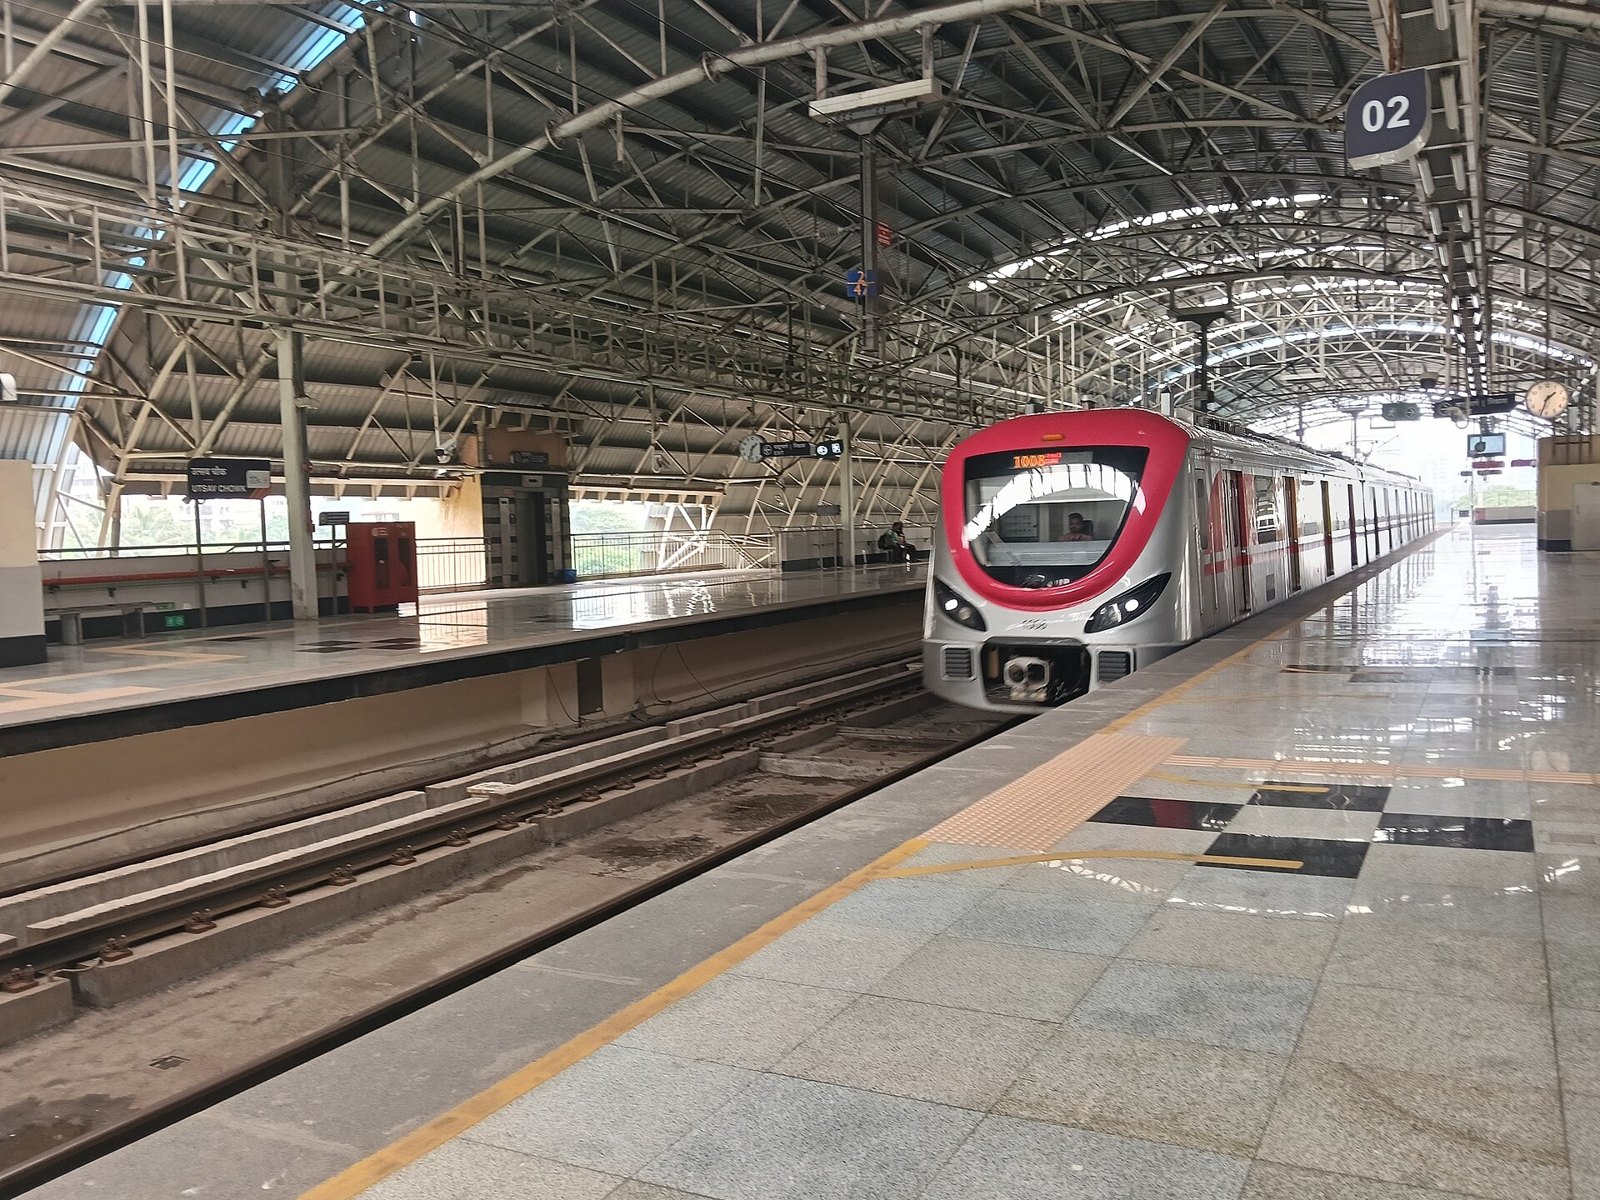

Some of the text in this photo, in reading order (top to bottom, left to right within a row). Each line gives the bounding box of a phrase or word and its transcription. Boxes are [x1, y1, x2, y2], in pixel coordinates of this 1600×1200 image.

[1361, 95, 1410, 132] 02
[191, 484, 247, 493] UTSAV CHOWK
